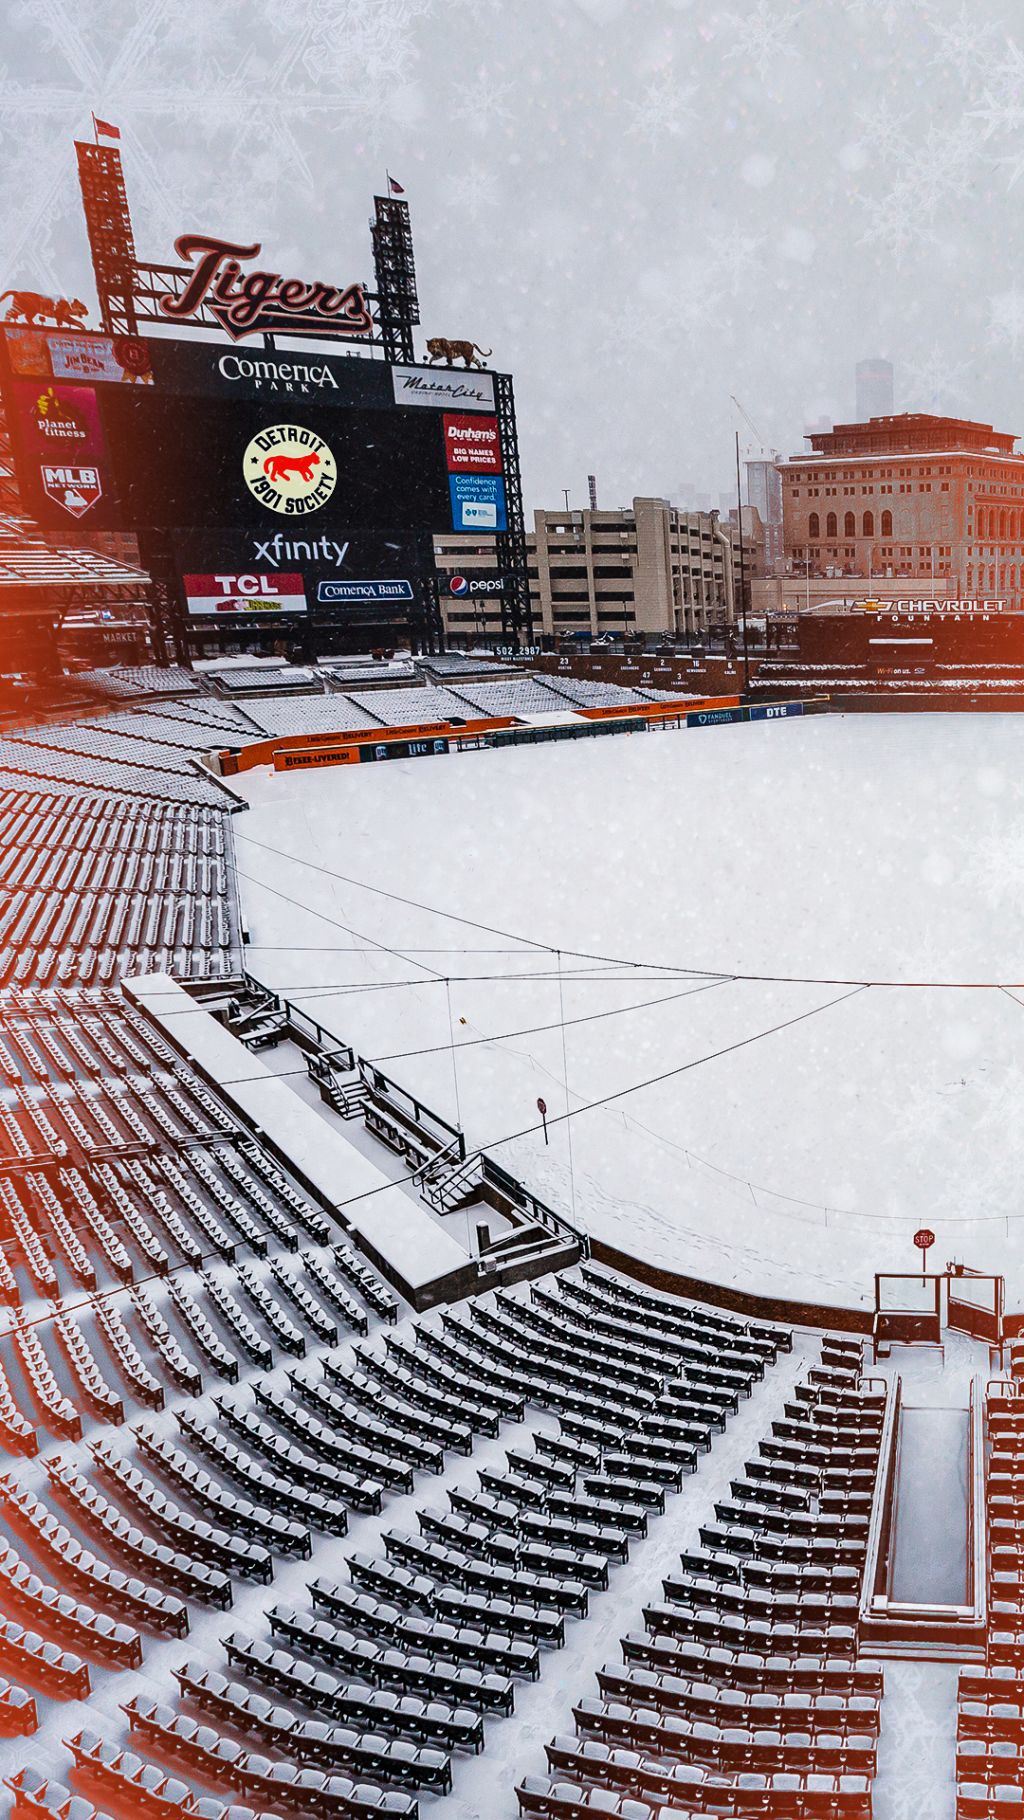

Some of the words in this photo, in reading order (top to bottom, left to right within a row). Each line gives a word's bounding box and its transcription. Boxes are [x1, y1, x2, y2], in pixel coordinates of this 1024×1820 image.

[159, 234, 373, 339] Tigers
[255, 380, 310, 393] PARK
[37, 418, 77, 430] planet
[45, 427, 86, 438] fitness
[447, 426, 497, 440] Dunham's
[254, 427, 326, 452] DETROIT
[453, 447, 466, 455] BIG
[468, 448, 494, 456] NAMES
[452, 455, 469, 463] LOW
[470, 456, 497, 464] PRICES
[45, 468, 96, 484] MLB
[455, 476, 497, 485] Confidence
[250, 475, 283, 509] 1901
[285, 472, 334, 513] SOCIETY
[456, 493, 478, 502] every
[253, 533, 349, 567] xfinity
[214, 574, 279, 595] TCL
[378, 584, 405, 595] Bank
[469, 578, 504, 592] pepsi
[897, 600, 1007, 612] CHEVROLET
[103, 632, 137, 643] MARKET
[496, 646, 513, 655] 502
[519, 646, 540, 655] 2987
[559, 657, 569, 665] 23
[766, 706, 787, 718] DTE
[915, 1235, 933, 1243] STOP
